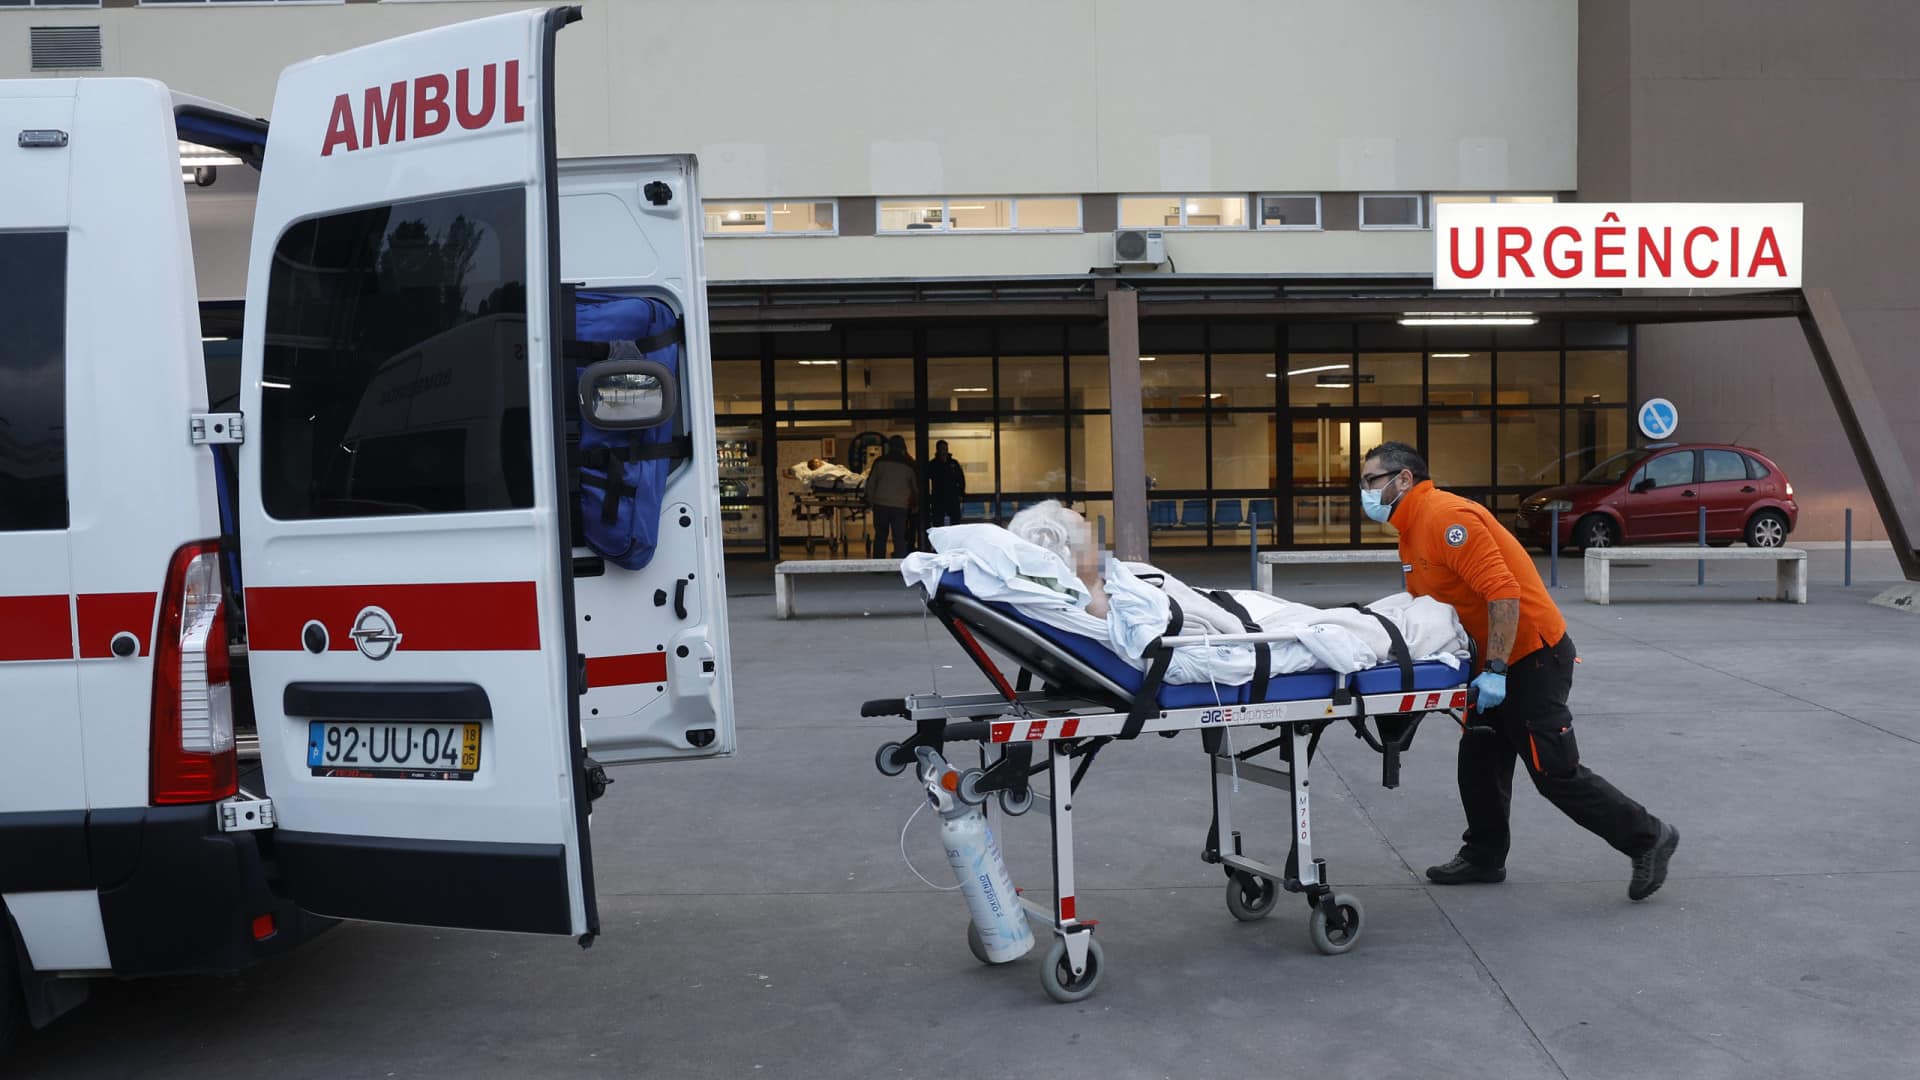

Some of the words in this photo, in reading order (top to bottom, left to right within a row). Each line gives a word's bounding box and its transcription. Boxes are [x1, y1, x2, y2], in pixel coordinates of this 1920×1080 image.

[320, 59, 525, 157] AMBUL
[1450, 211, 1788, 279] URGÊNCIA
[465, 729, 476, 741] 18
[463, 753, 474, 765] 05
